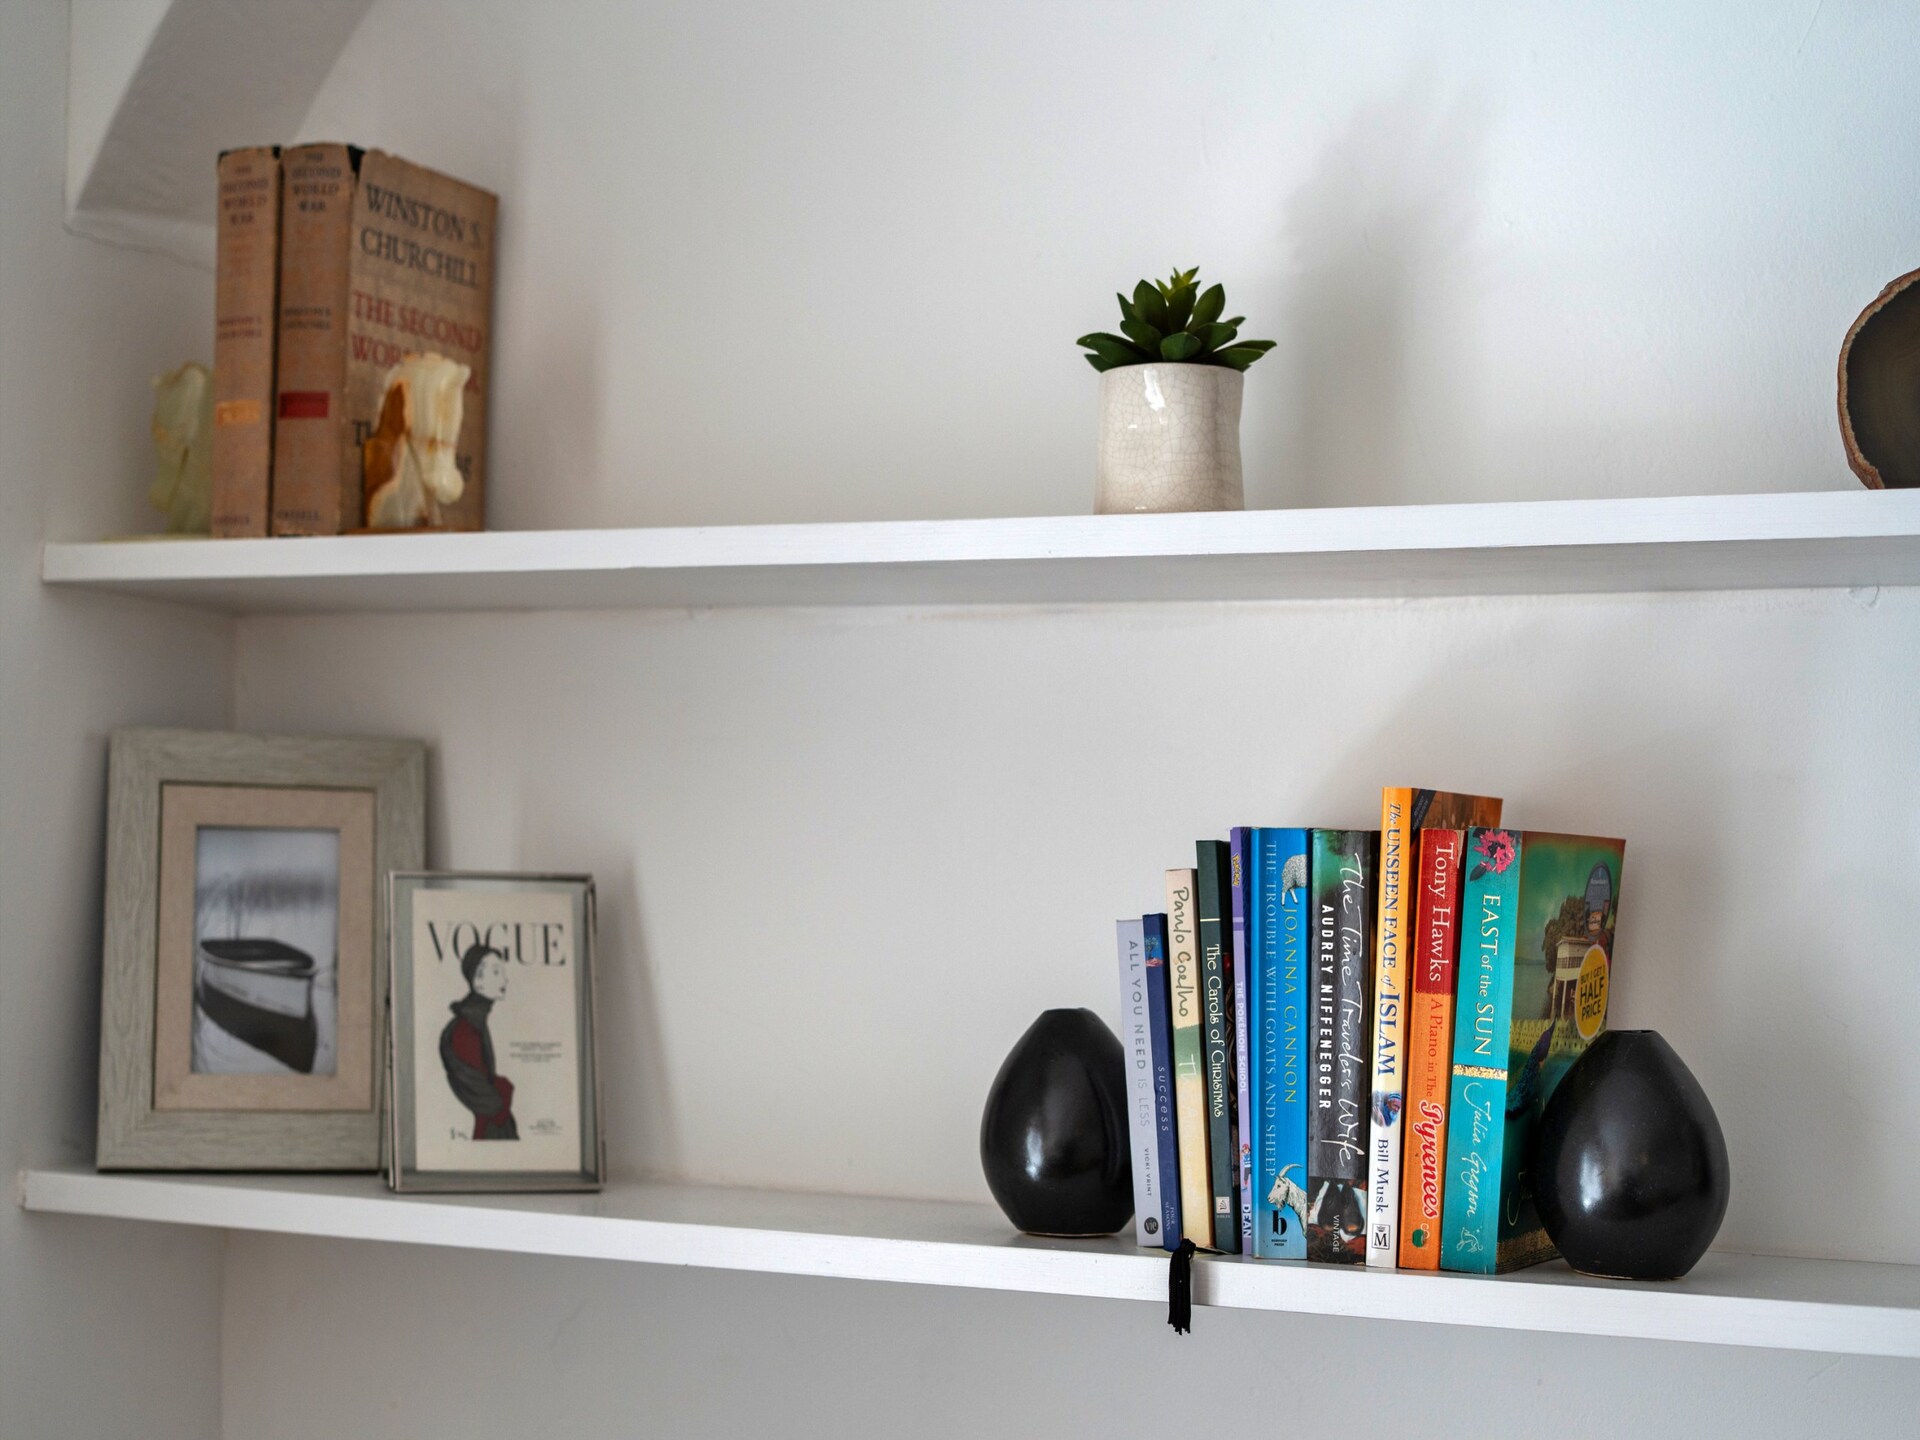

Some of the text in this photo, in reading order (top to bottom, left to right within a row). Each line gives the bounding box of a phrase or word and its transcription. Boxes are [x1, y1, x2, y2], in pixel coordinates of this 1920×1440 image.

[366, 182, 464, 242] WINSTON
[360, 226, 481, 290] CHURCHILL
[353, 290, 482, 354] THE SECOND
[428, 920, 566, 967] VOGUE
[1377, 803, 1402, 1077] The UNSEEN FACE of ISLAM
[1427, 842, 1455, 982] Tony Hawks
[1173, 886, 1195, 1017] Paulo Coelho
[1206, 944, 1220, 970] The
[1472, 893, 1500, 1056] EAST of the SUN
[1593, 966, 1603, 978] GET
[1207, 975, 1223, 1024] Carols
[1265, 840, 1277, 1176] THE TROUBLE WITH GOATS AND SHEEP
[1283, 907, 1298, 1103] JOANNA CANNON
[1319, 904, 1334, 1109] AUDREY NIFFENEGGER
[1320, 852, 1365, 1167] The Time Traveler's Wife
[1580, 976, 1604, 1006] HALF
[1582, 999, 1601, 1022] PRICE
[1128, 940, 1150, 1127] ALL YOU NEED IS LESS
[1210, 1029, 1225, 1047] of
[1426, 998, 1443, 1097] A Piano in The
[1239, 1055, 1247, 1092] SCHOOL
[1375, 1139, 1389, 1213] Bill Musk
[1412, 1100, 1445, 1219] Pyrenees
[1460, 1082, 1491, 1218] Julia Gregson
[1242, 1203, 1252, 1239] DEAN
[1272, 1210, 1287, 1236] b
[1332, 1214, 1340, 1253] VINTAGE
[1374, 1233, 1387, 1247] M
